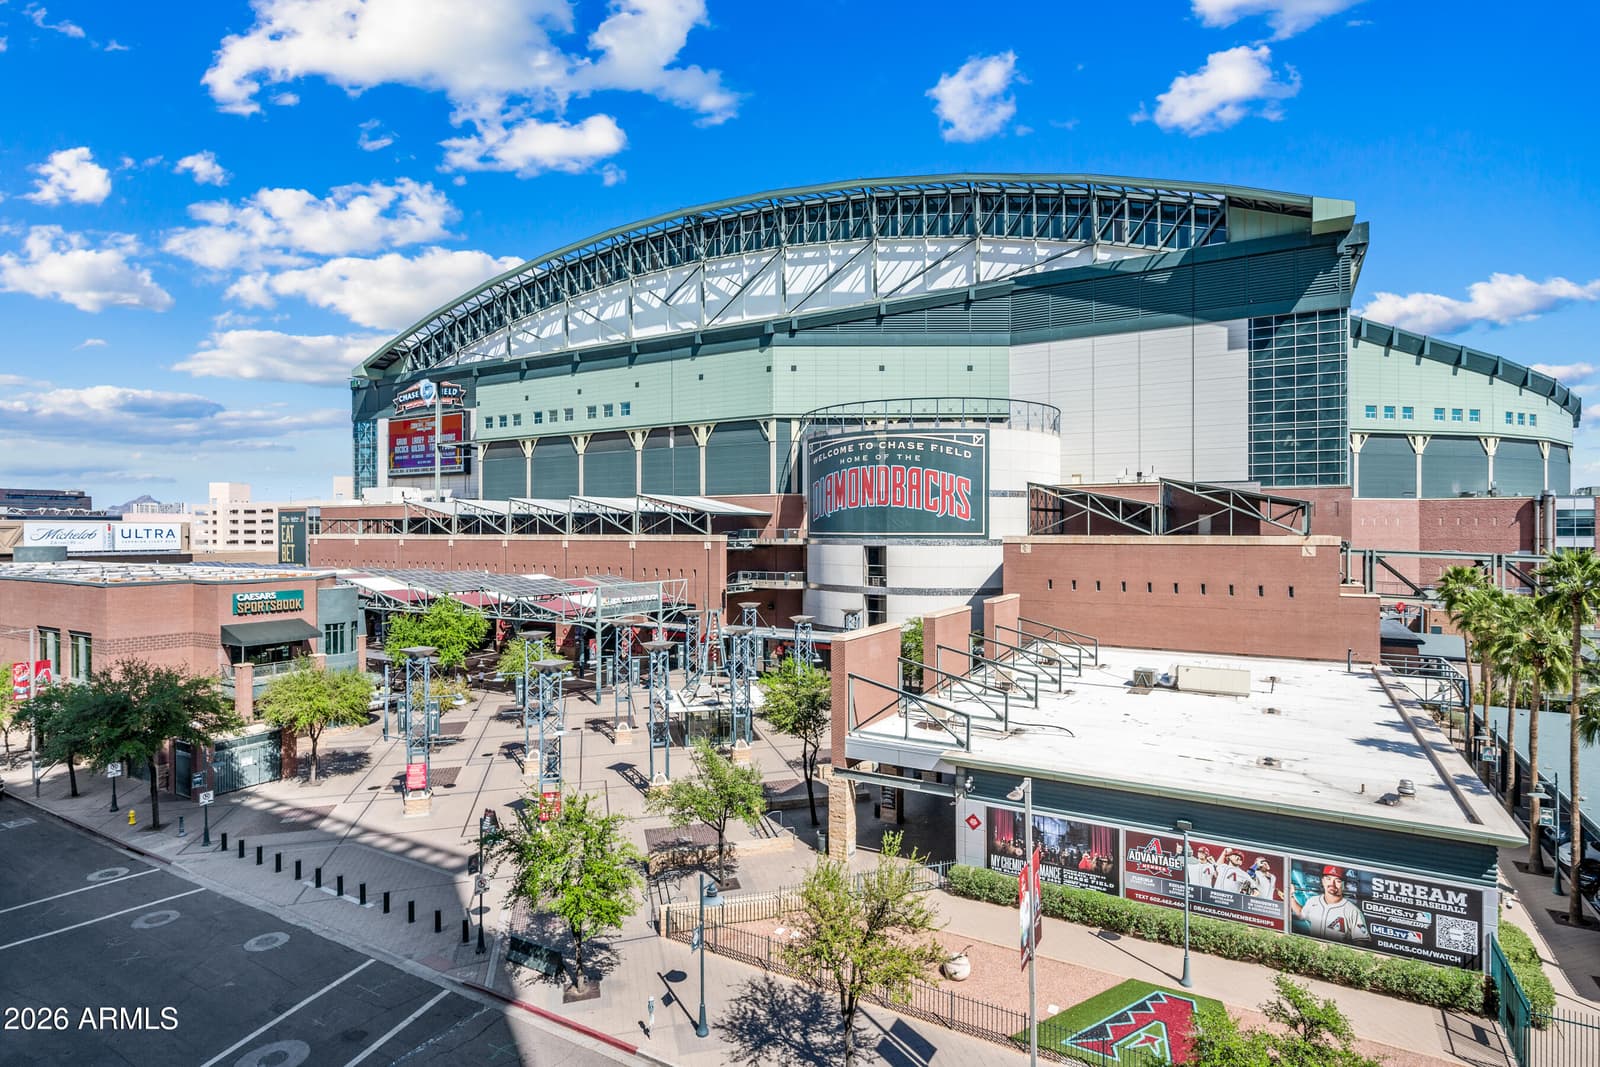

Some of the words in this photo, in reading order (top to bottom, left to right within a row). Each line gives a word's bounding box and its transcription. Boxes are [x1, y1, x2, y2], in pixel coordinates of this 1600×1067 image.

[399, 391, 420, 403] CHASE
[441, 387, 458, 396] IELD
[813, 444, 855, 464] WELCOME
[860, 441, 874, 451] TO
[878, 441, 925, 451] CHASE
[930, 443, 972, 459] FIELD
[840, 453, 869, 464] HOME
[875, 453, 890, 461] OF
[896, 453, 921, 462] THE
[812, 466, 972, 522] DIAMONDBACKS
[31, 528, 98, 541] Michelob
[121, 528, 176, 539] ULTRA
[281, 524, 294, 543] EAT
[281, 543, 295, 562] BET
[236, 592, 277, 601] CAESARS
[237, 599, 302, 613] SPORTSBOOK
[991, 854, 1001, 867] MY
[1039, 864, 1062, 880] MANCE
[1129, 850, 1181, 869] ADVANTAGE
[1142, 863, 1170, 872] MEMBER
[1063, 874, 1089, 883] CHASE
[1091, 879, 1115, 888] FIELD
[1371, 877, 1468, 907] STREAM
[1373, 891, 1414, 905] D-BACKS
[1415, 899, 1468, 915] BASEBALL
[1193, 905, 1275, 927] DBACKS.COM/MEMBERSHIPS
[1377, 940, 1462, 963] DBACKS.COM/WATCH
